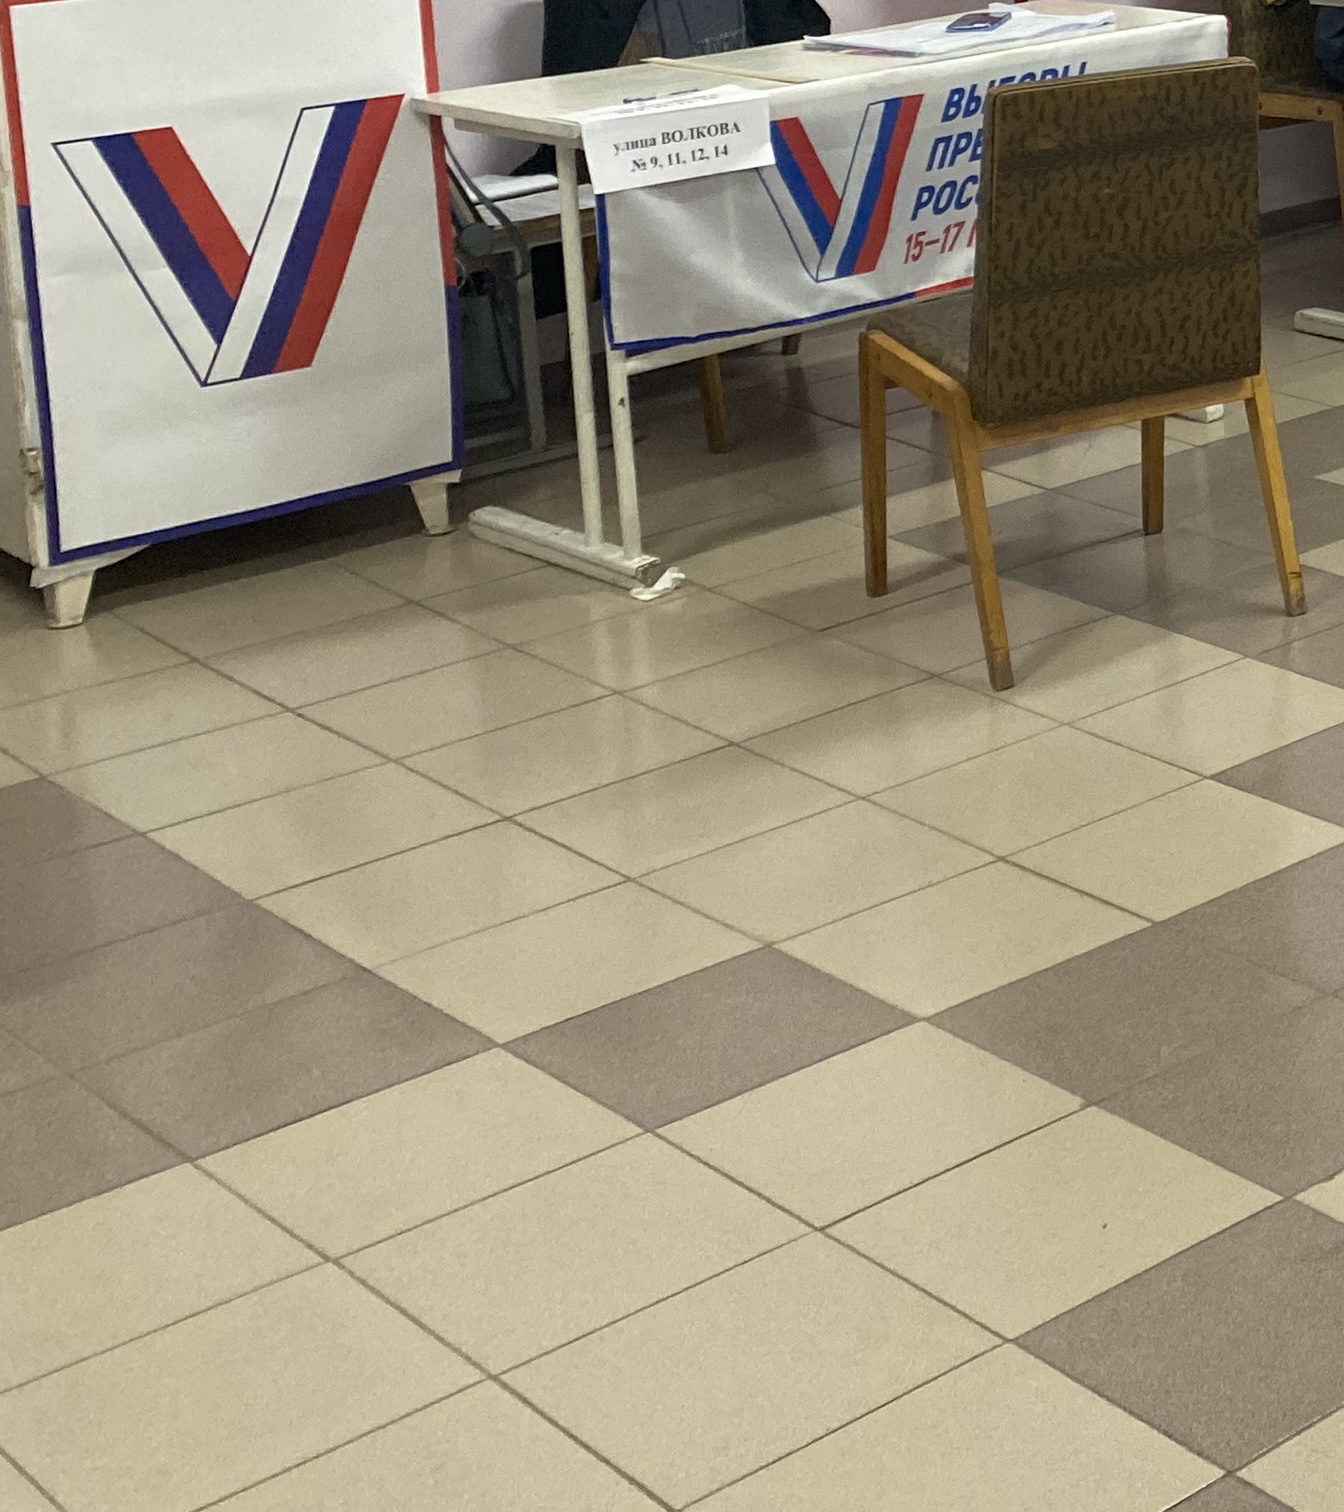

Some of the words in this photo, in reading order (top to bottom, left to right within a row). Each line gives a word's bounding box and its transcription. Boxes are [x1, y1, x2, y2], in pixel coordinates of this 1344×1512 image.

[613, 136, 657, 156] улица
[661, 121, 742, 146] ВОЛКОВА
[630, 158, 647, 173] №
[650, 155, 664, 170] 9,
[667, 152, 687, 167] 11,
[691, 148, 710, 162] 12,
[714, 144, 729, 158] 14
